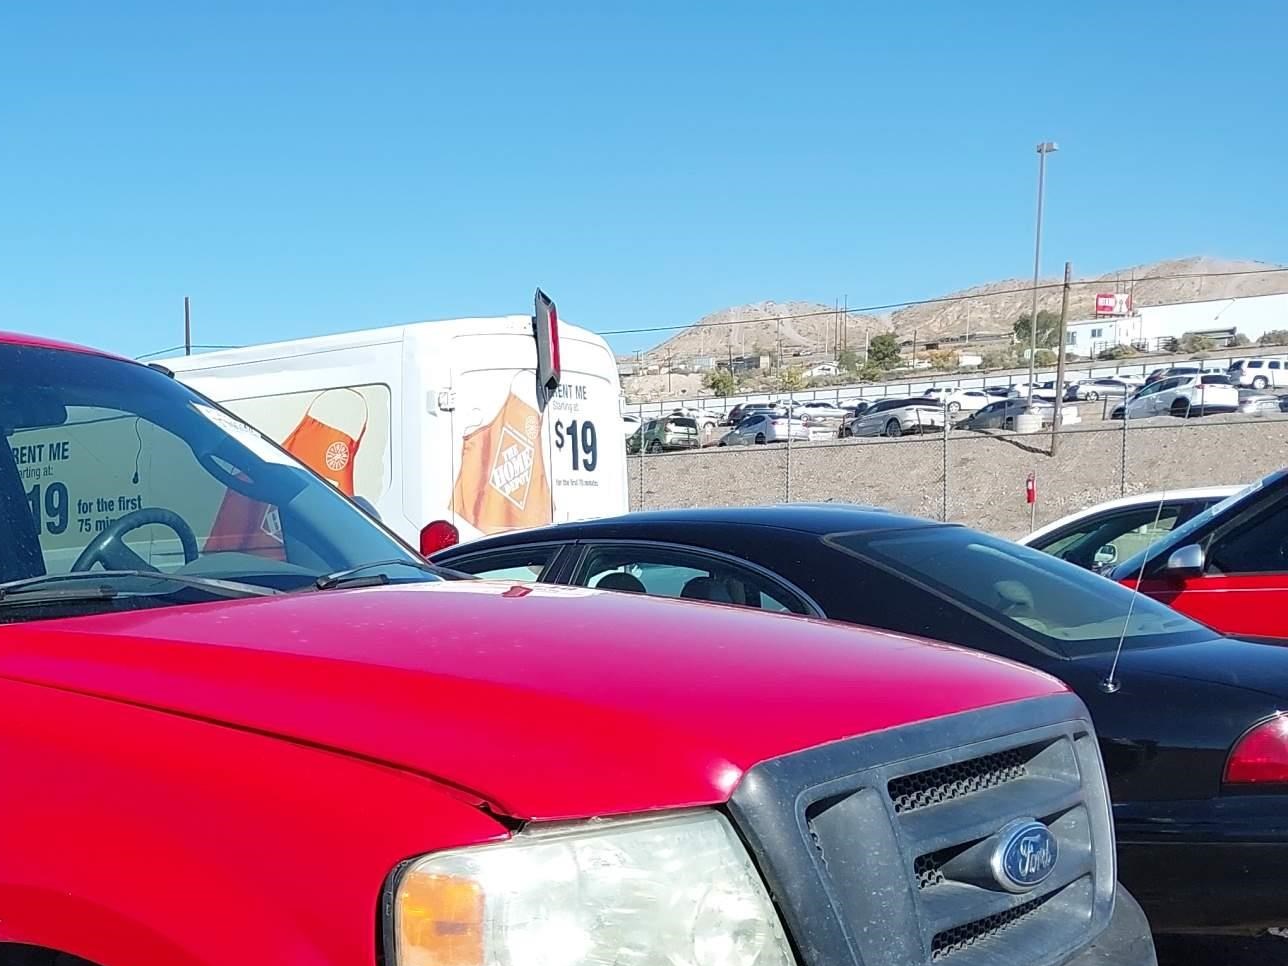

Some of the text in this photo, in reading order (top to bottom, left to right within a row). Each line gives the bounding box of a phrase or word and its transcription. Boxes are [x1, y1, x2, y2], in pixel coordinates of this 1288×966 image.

[575, 385, 587, 400] ME
[49, 441, 70, 461] ME
[555, 418, 598, 472] $19
[43, 464, 54, 477] at:
[493, 447, 533, 487] HOME
[77, 495, 142, 514] for the first
[77, 518, 91, 533] 75
[1017, 834, 1052, 877] Ford
